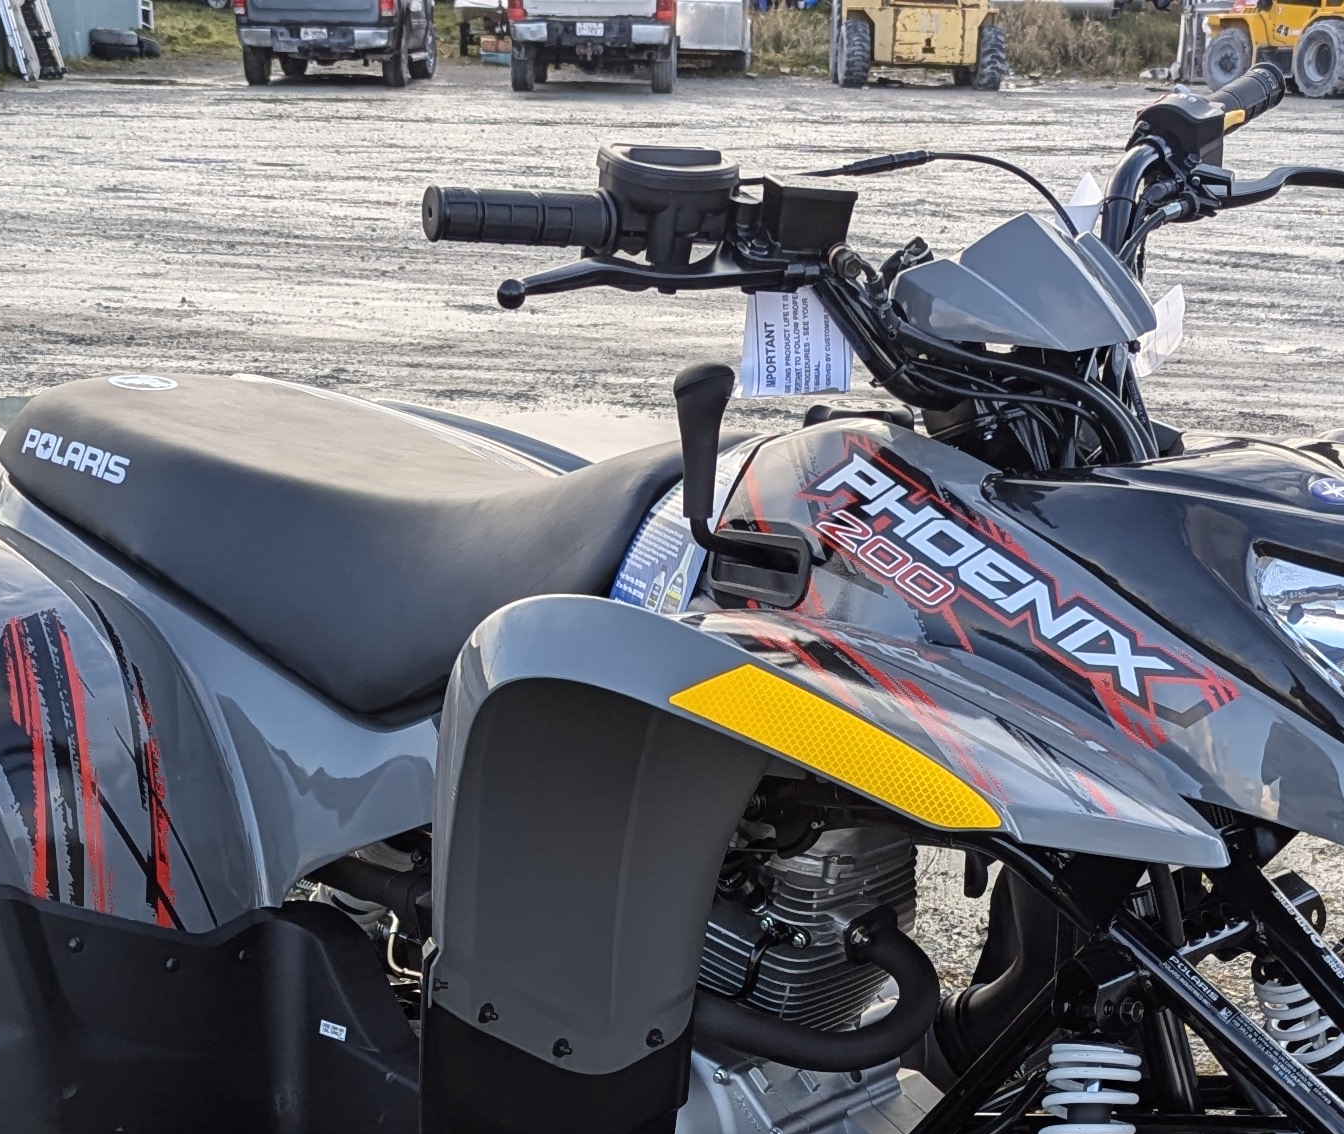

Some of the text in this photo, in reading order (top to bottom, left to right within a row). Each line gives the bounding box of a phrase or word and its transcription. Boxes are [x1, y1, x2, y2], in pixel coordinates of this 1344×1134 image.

[793, 322, 801, 355] FOLLOW
[21, 428, 131, 484] POLARIS
[816, 511, 956, 607] 200
[816, 453, 1175, 698] PHOENIX
[1169, 955, 1219, 1001] POLARIS
